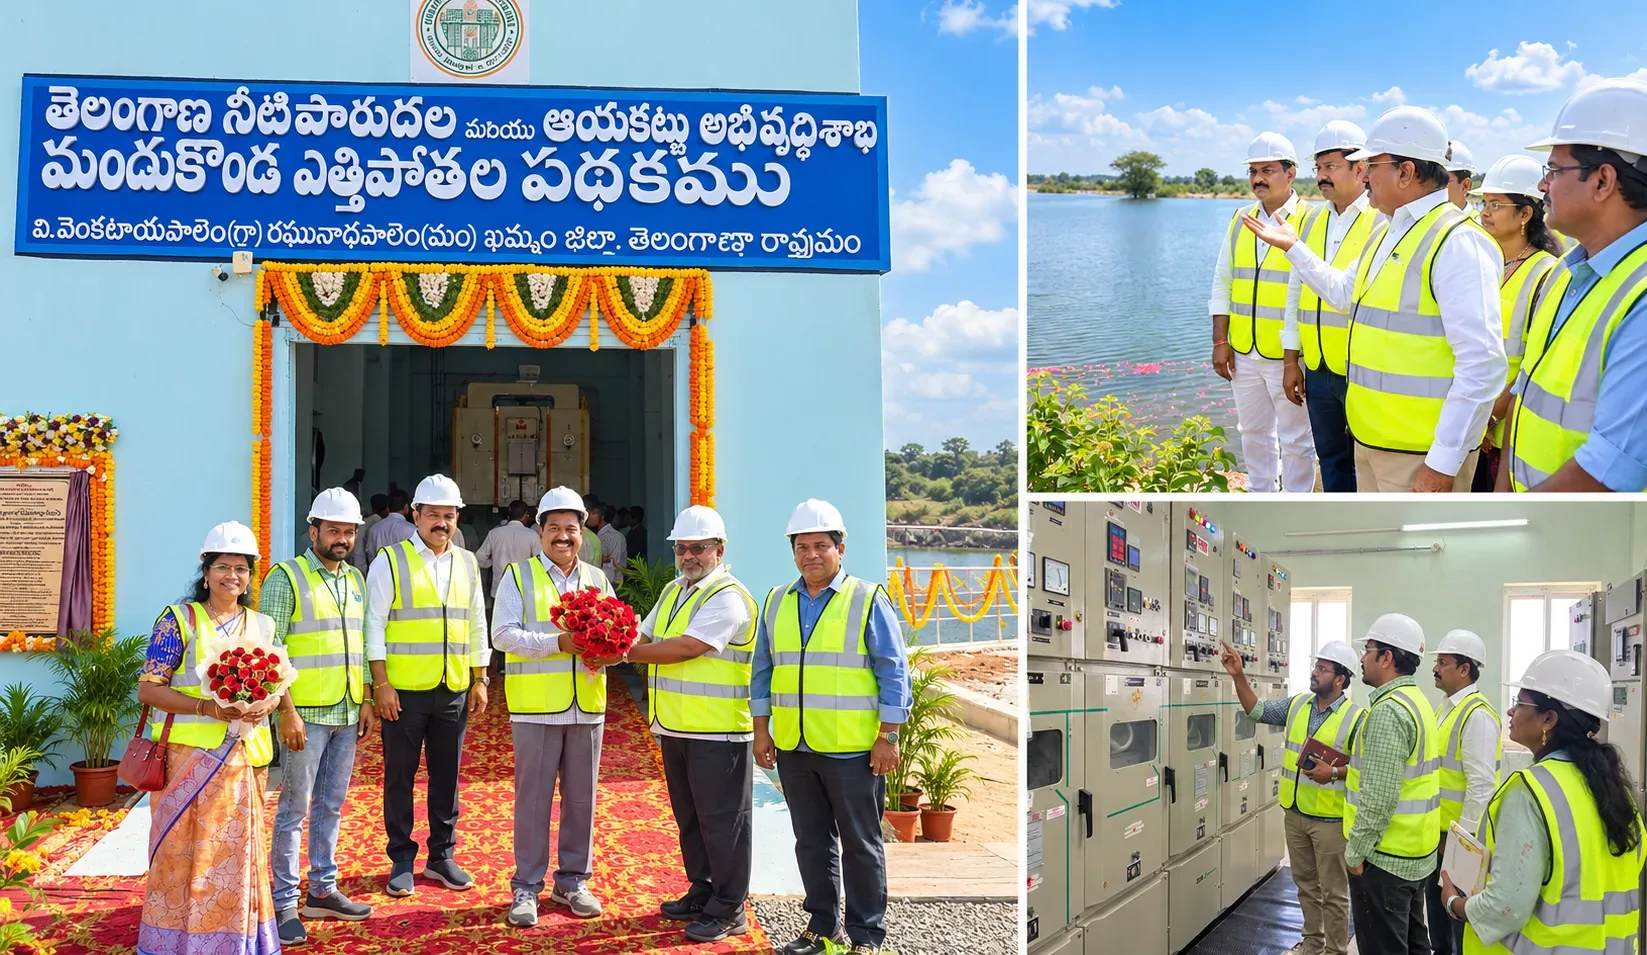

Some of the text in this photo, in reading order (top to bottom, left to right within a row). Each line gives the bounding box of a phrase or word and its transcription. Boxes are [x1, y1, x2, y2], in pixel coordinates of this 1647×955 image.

[46, 86, 213, 135] తెలంగాణ
[42, 136, 791, 213] మందుకొండ ఎత్తిపోతల పథకము
